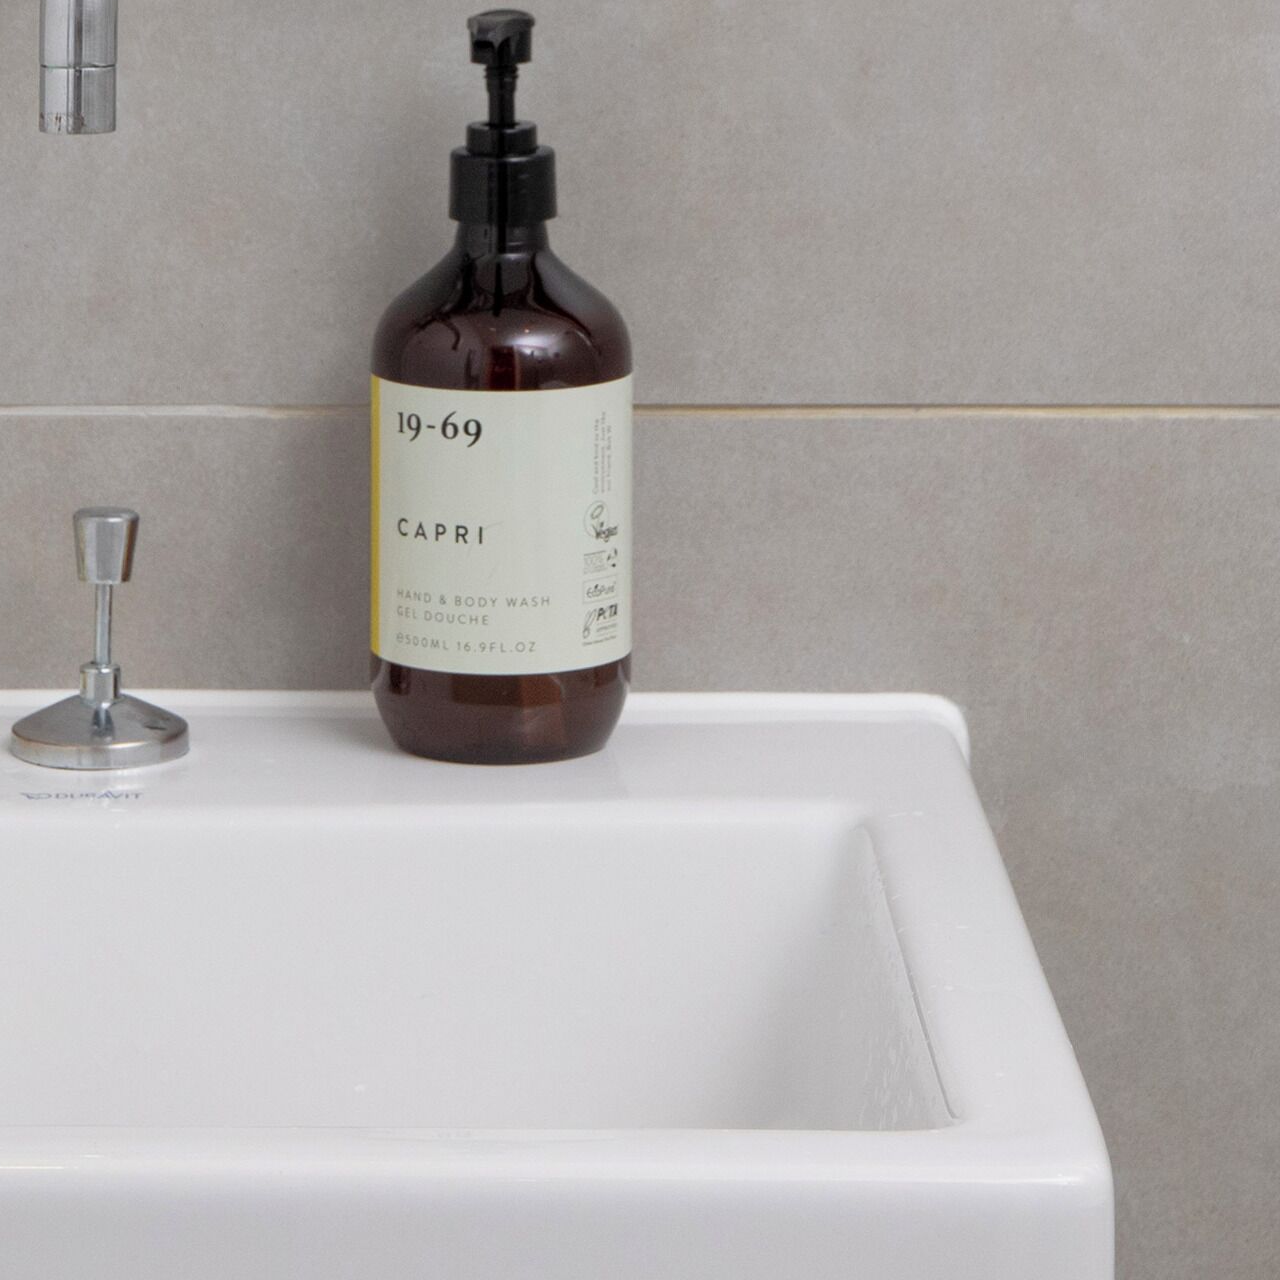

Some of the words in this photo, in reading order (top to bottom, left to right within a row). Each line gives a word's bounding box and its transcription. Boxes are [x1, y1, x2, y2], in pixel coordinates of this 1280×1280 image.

[397, 411, 483, 448] 19-69
[397, 517, 484, 545] CAPRI
[396, 588, 432, 603] HAND
[439, 594, 447, 605] &
[455, 596, 498, 608] BODY
[505, 596, 551, 608] WASH
[396, 605, 418, 620] GEL
[424, 610, 490, 625] DOUCHE
